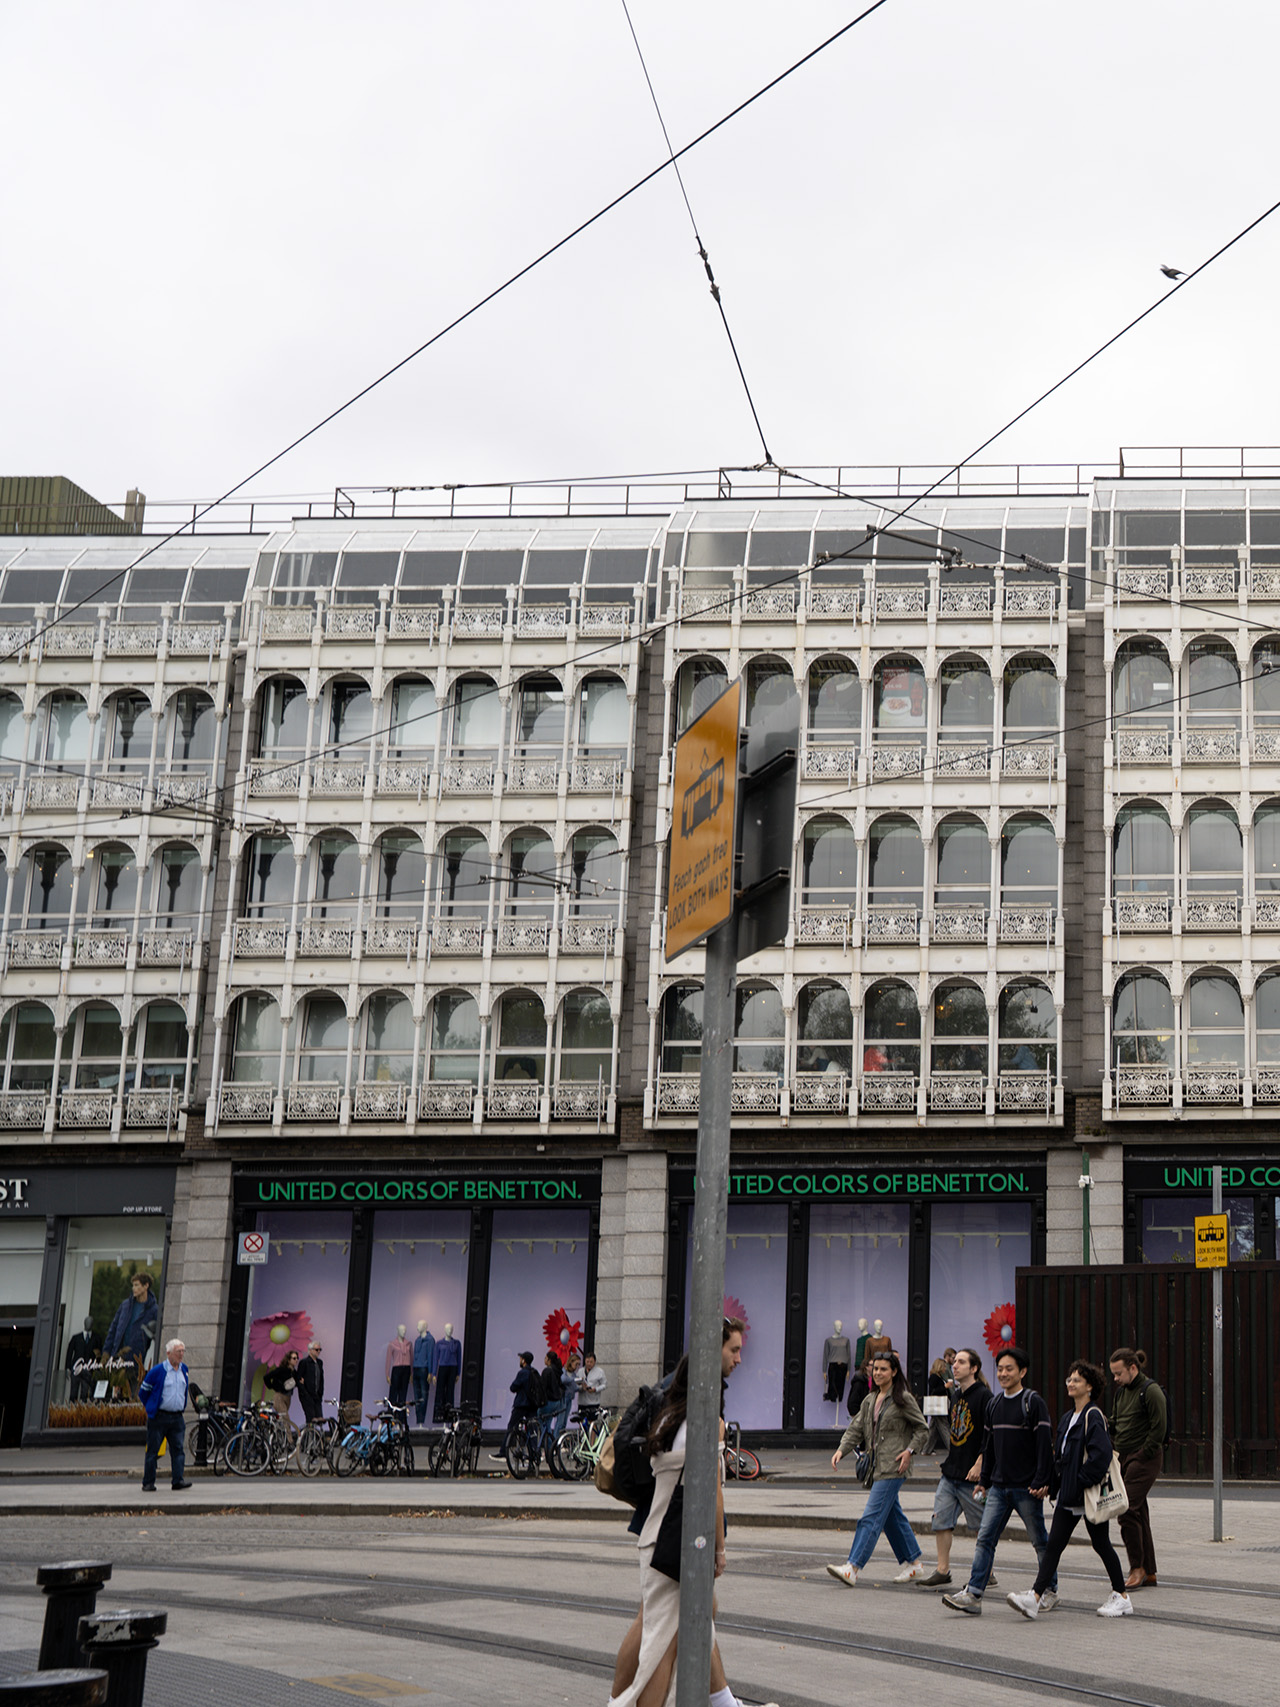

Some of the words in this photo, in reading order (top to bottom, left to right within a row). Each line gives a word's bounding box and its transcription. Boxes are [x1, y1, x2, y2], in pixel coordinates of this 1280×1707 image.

[669, 899, 687, 931] LOOK
[688, 884, 707, 917] BOTH
[708, 867, 729, 902] WAYS
[777, 1174, 869, 1194] COLORS
[872, 1173, 904, 1193] OF
[906, 1173, 1029, 1193] BENETTON.
[1164, 1167, 1246, 1187] UNITED
[258, 1181, 337, 1201] UNITED
[340, 1181, 428, 1200] COLORS
[430, 1181, 459, 1200] OF
[463, 1180, 582, 1199] BENETTON.
[73, 1357, 103, 1376] Golden
